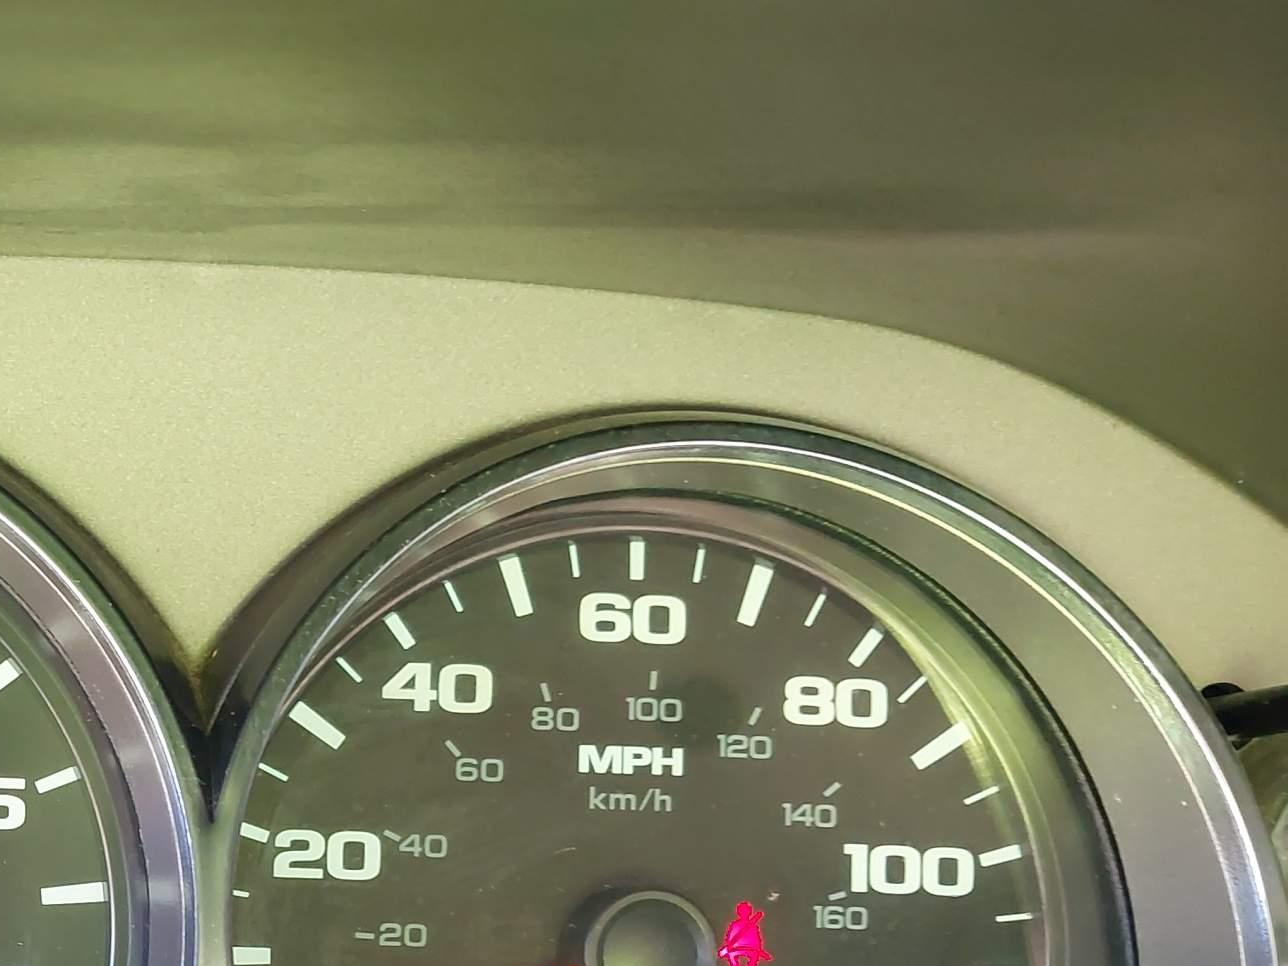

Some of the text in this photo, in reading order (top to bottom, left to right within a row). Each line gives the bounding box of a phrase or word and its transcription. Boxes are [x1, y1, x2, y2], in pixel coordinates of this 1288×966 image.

[579, 592, 687, 645] 60
[381, 662, 493, 714] 40
[625, 697, 683, 722] 100
[782, 675, 888, 728] 80
[531, 706, 580, 732] 80
[716, 734, 772, 760] 120
[455, 757, 504, 782] 60
[578, 744, 684, 777] MPH
[588, 786, 672, 812] km/h
[781, 802, 837, 828] 140
[273, 829, 382, 881] 20
[398, 834, 448, 859] 40
[842, 843, 975, 898] 100
[813, 905, 868, 930] 160
[378, 922, 428, 948] 20
